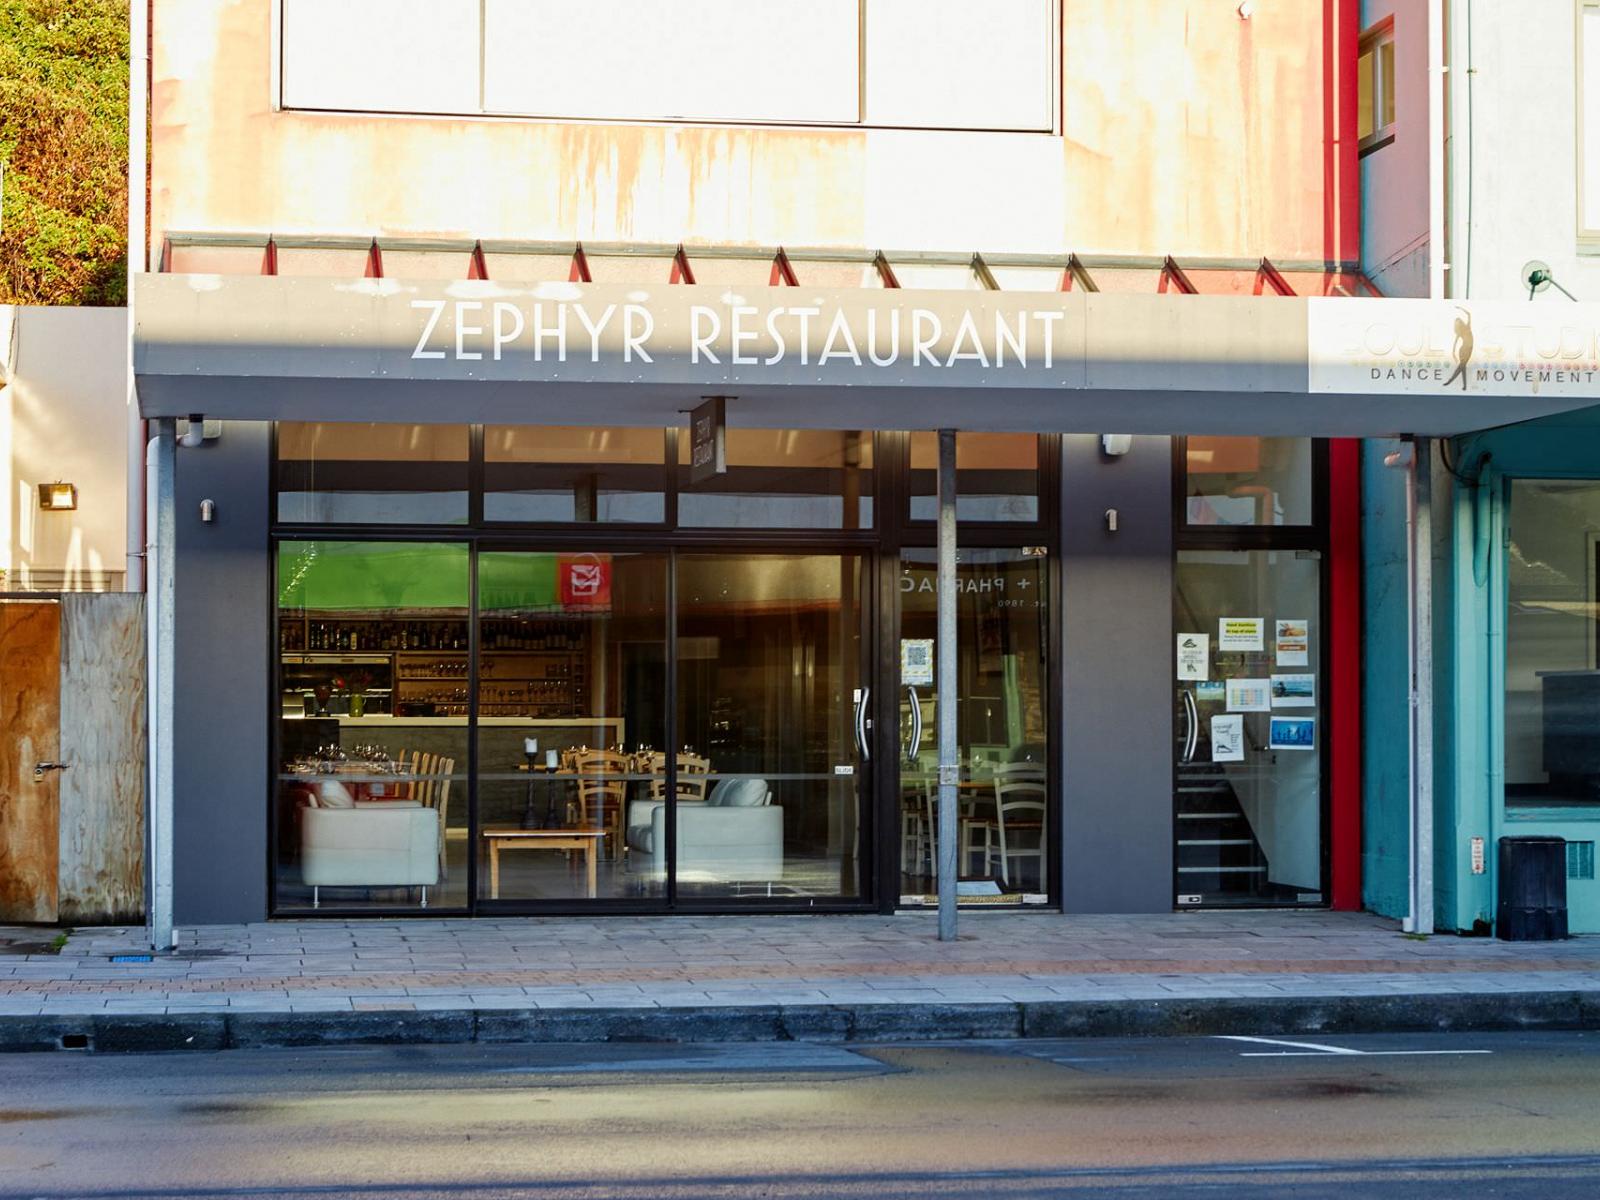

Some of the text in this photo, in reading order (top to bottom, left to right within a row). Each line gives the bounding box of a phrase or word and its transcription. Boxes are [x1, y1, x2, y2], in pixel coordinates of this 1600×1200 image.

[411, 300, 1065, 368] ZEPHYR RESTAURANT
[1478, 324, 1600, 361] STUDI
[1371, 368, 1594, 384] DANCE MOVEMENT
